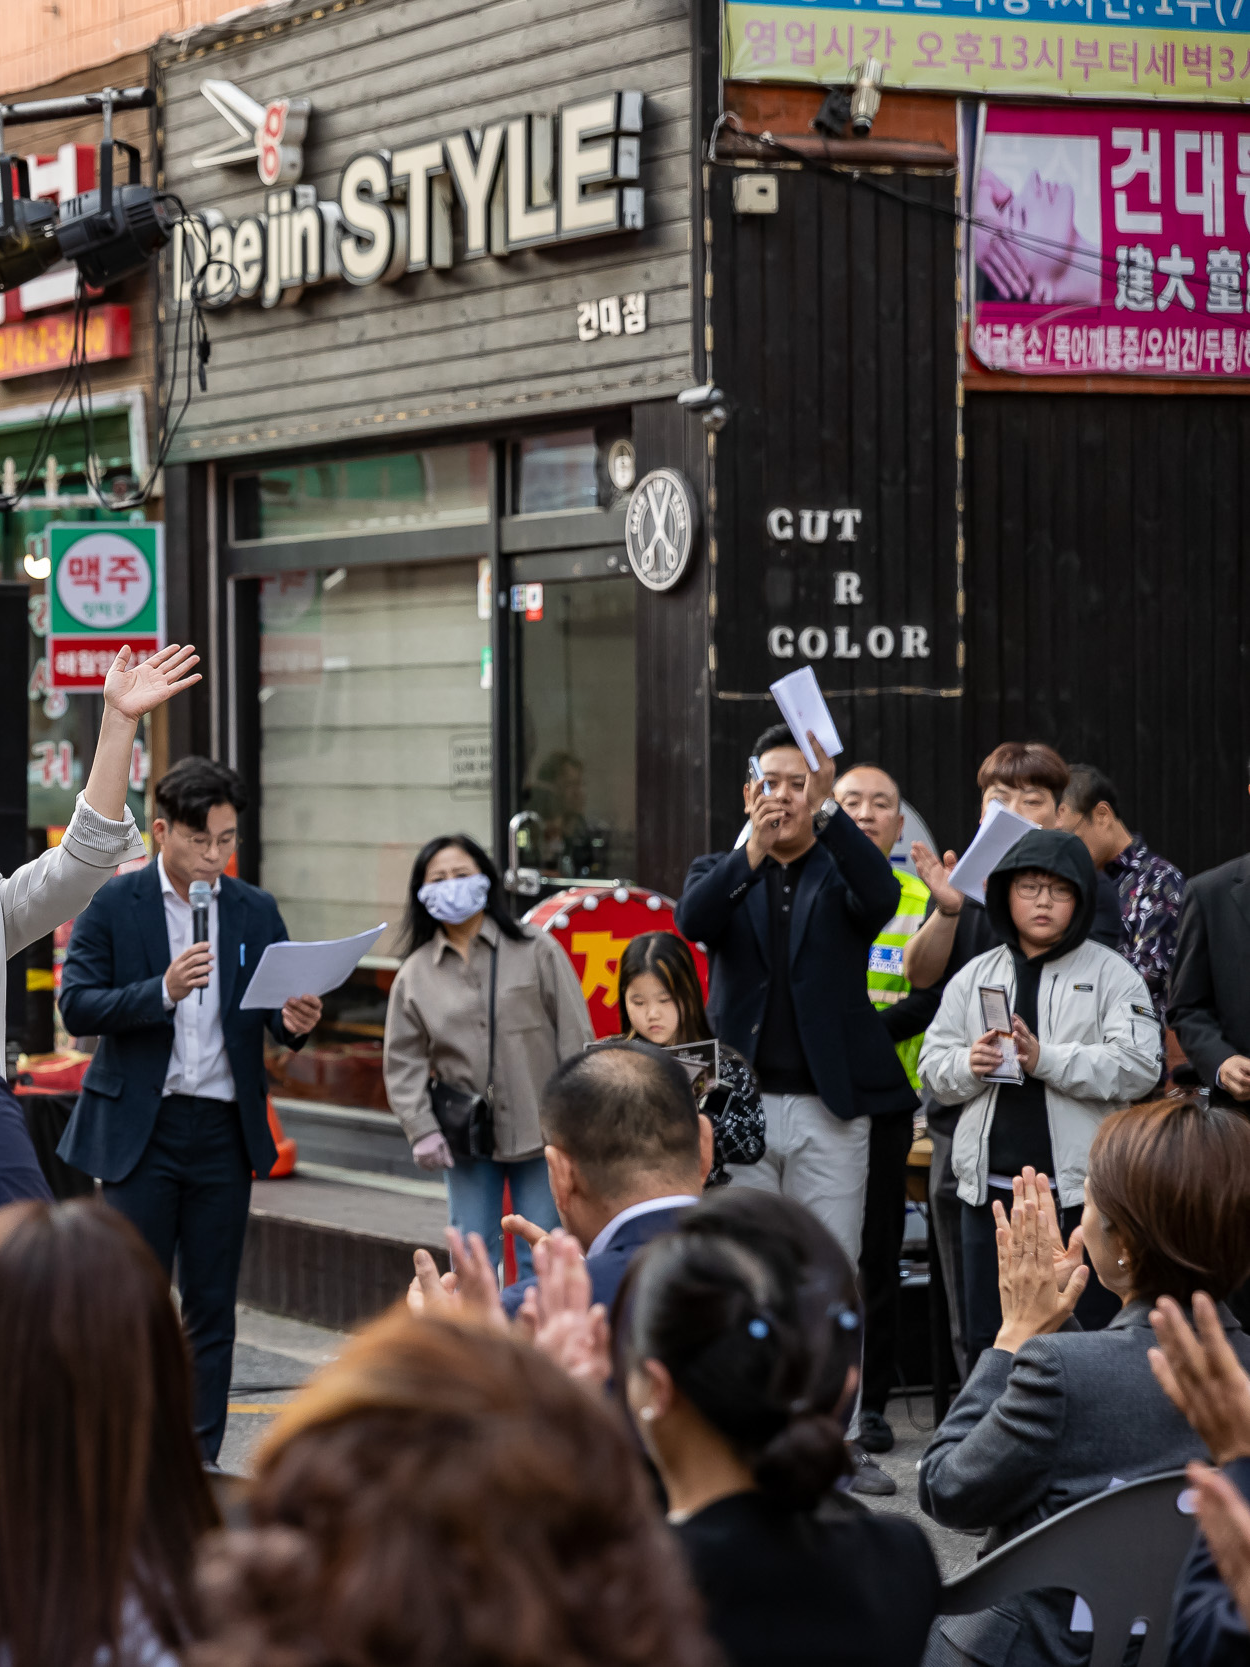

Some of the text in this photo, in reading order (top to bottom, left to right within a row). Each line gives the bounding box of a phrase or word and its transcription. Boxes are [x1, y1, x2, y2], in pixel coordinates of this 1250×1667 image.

[744, 19, 897, 70] 영업시간
[172, 92, 624, 308] Daejin STYLE
[1111, 127, 1250, 237] 건대
[1114, 243, 1250, 314] 建大童
[576, 293, 647, 341] 건대점
[767, 508, 863, 542] CUT
[68, 554, 141, 595] 맥주
[833, 571, 863, 606] R
[768, 625, 930, 660] COLOR
